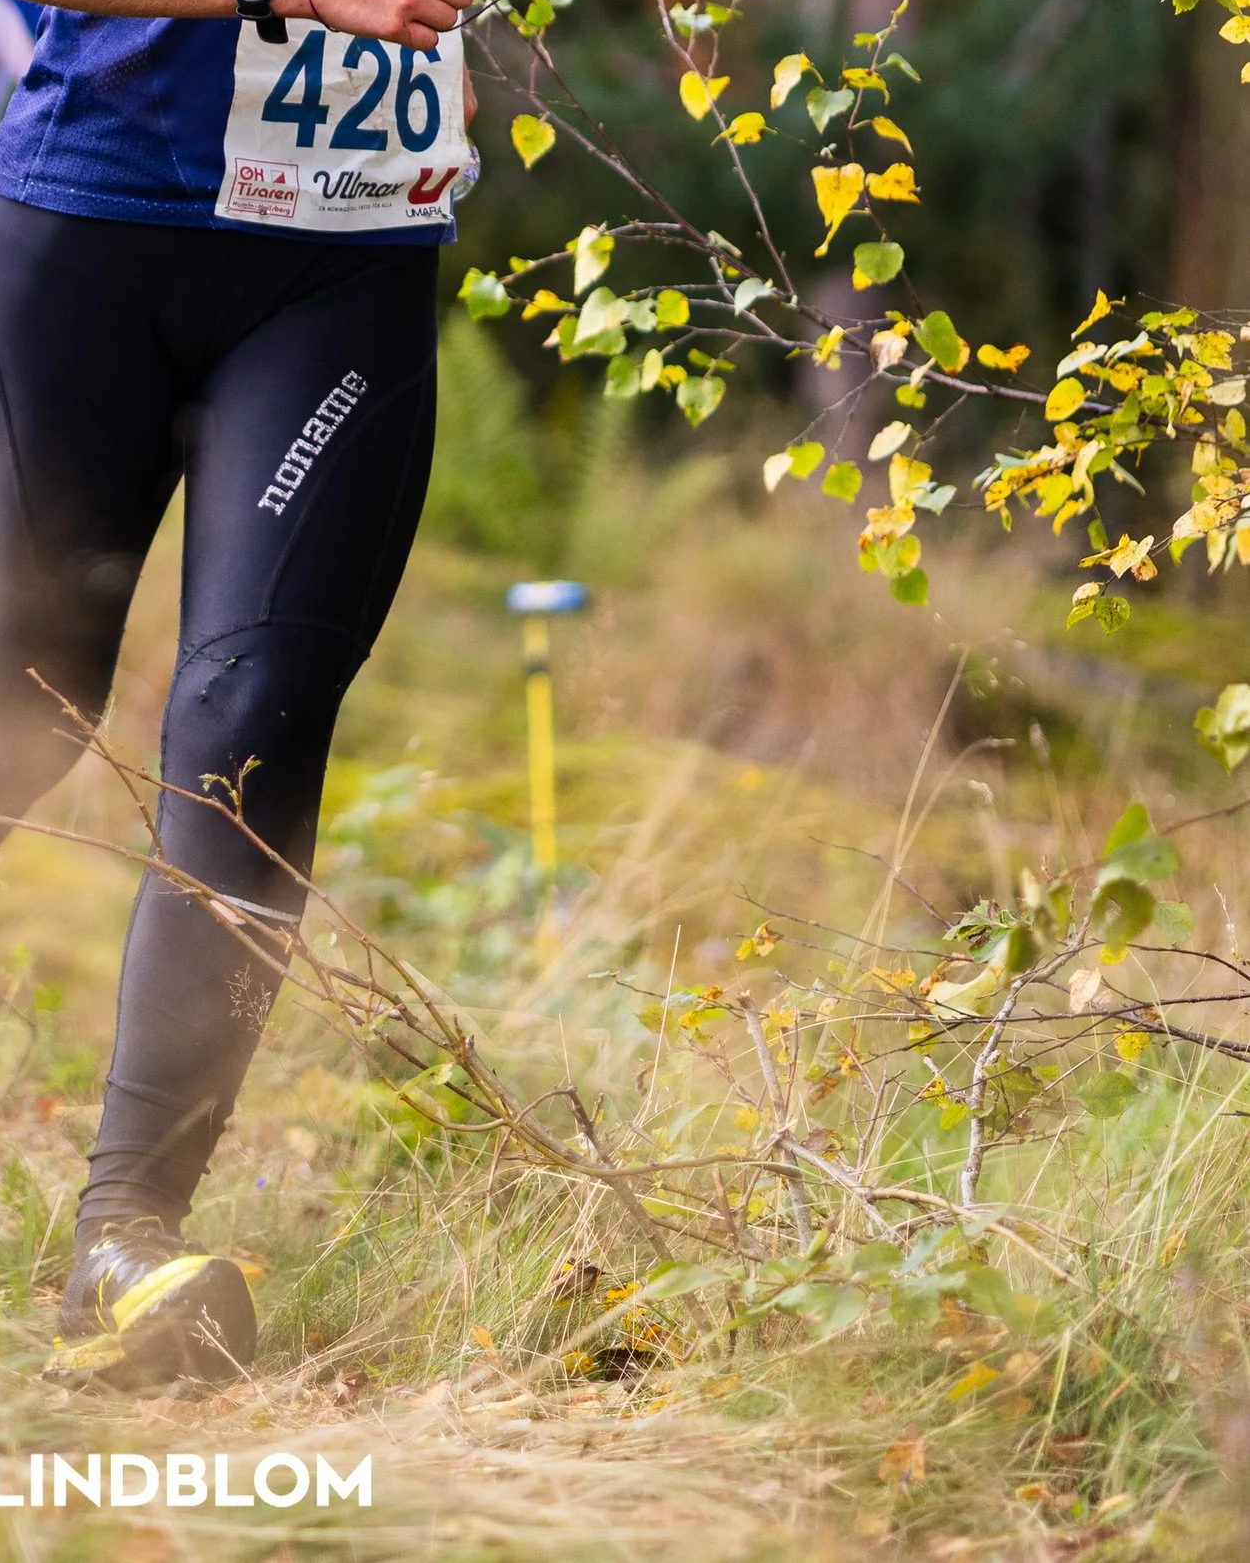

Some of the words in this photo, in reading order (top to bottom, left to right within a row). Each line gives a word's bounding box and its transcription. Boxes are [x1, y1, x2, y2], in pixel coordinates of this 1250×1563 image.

[261, 29, 442, 153] 426
[238, 182, 294, 201] Tisaren
[258, 370, 368, 516] noname
